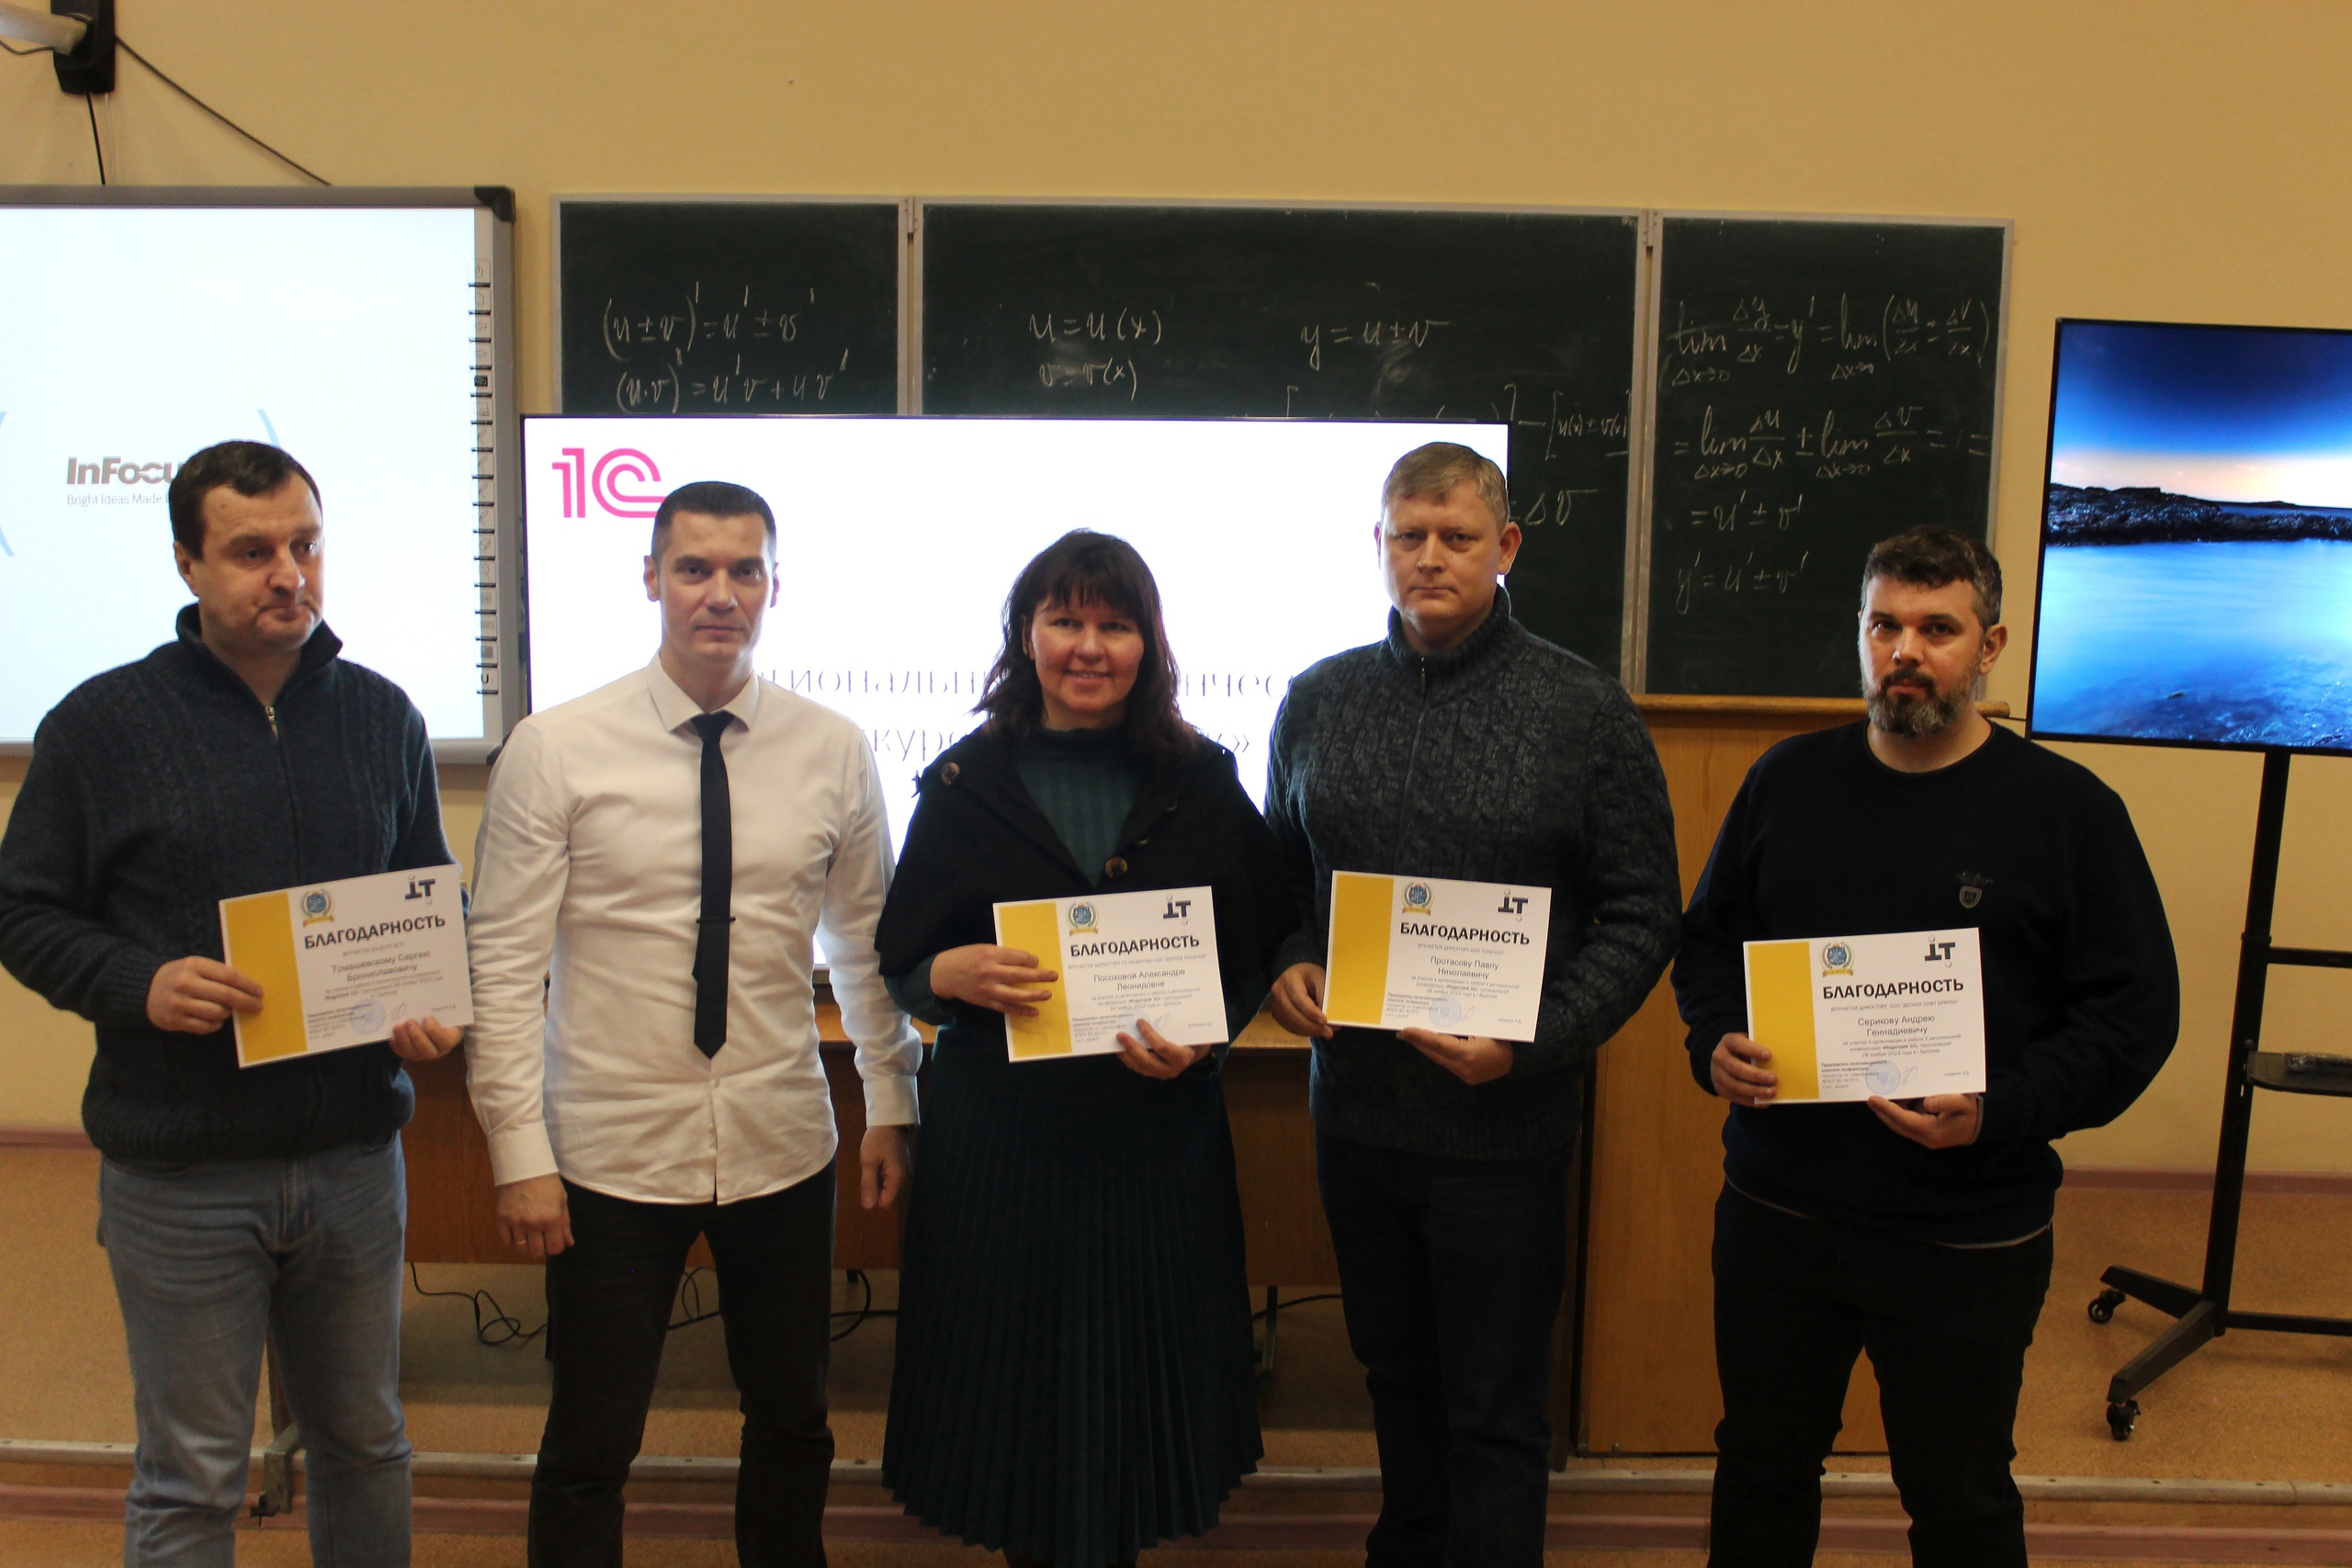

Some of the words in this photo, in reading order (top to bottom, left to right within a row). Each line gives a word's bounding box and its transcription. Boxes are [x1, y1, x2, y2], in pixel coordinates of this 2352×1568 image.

[67, 457, 185, 485] InFocu
[67, 494, 98, 507] Bright
[101, 494, 130, 504] Ideas
[132, 493, 162, 504] Made
[304, 914, 446, 950] БЛАГОДАРНОСТЬ
[1399, 921, 1530, 946] БЛАГОДАРНОСТЬ
[1069, 934, 1200, 958] БЛАГОДАРНОСТЬ
[398, 950, 430, 963] Сергею
[1430, 955, 1472, 967] Протасову
[1474, 959, 1498, 970] Павлу
[346, 963, 418, 982] Брониславовичу
[1093, 971, 1136, 983] Посоховой
[1138, 966, 1185, 979] Александре
[1437, 966, 1489, 979] Николаевичу
[1116, 978, 1165, 991] Леонидовне
[1822, 978, 1963, 1000] БЛАГОДАРНОСТЬ
[1857, 1016, 1898, 1027] Серикову
[1901, 1013, 1935, 1024] Андрею
[1866, 1025, 1928, 1037] Геннадиевичу
